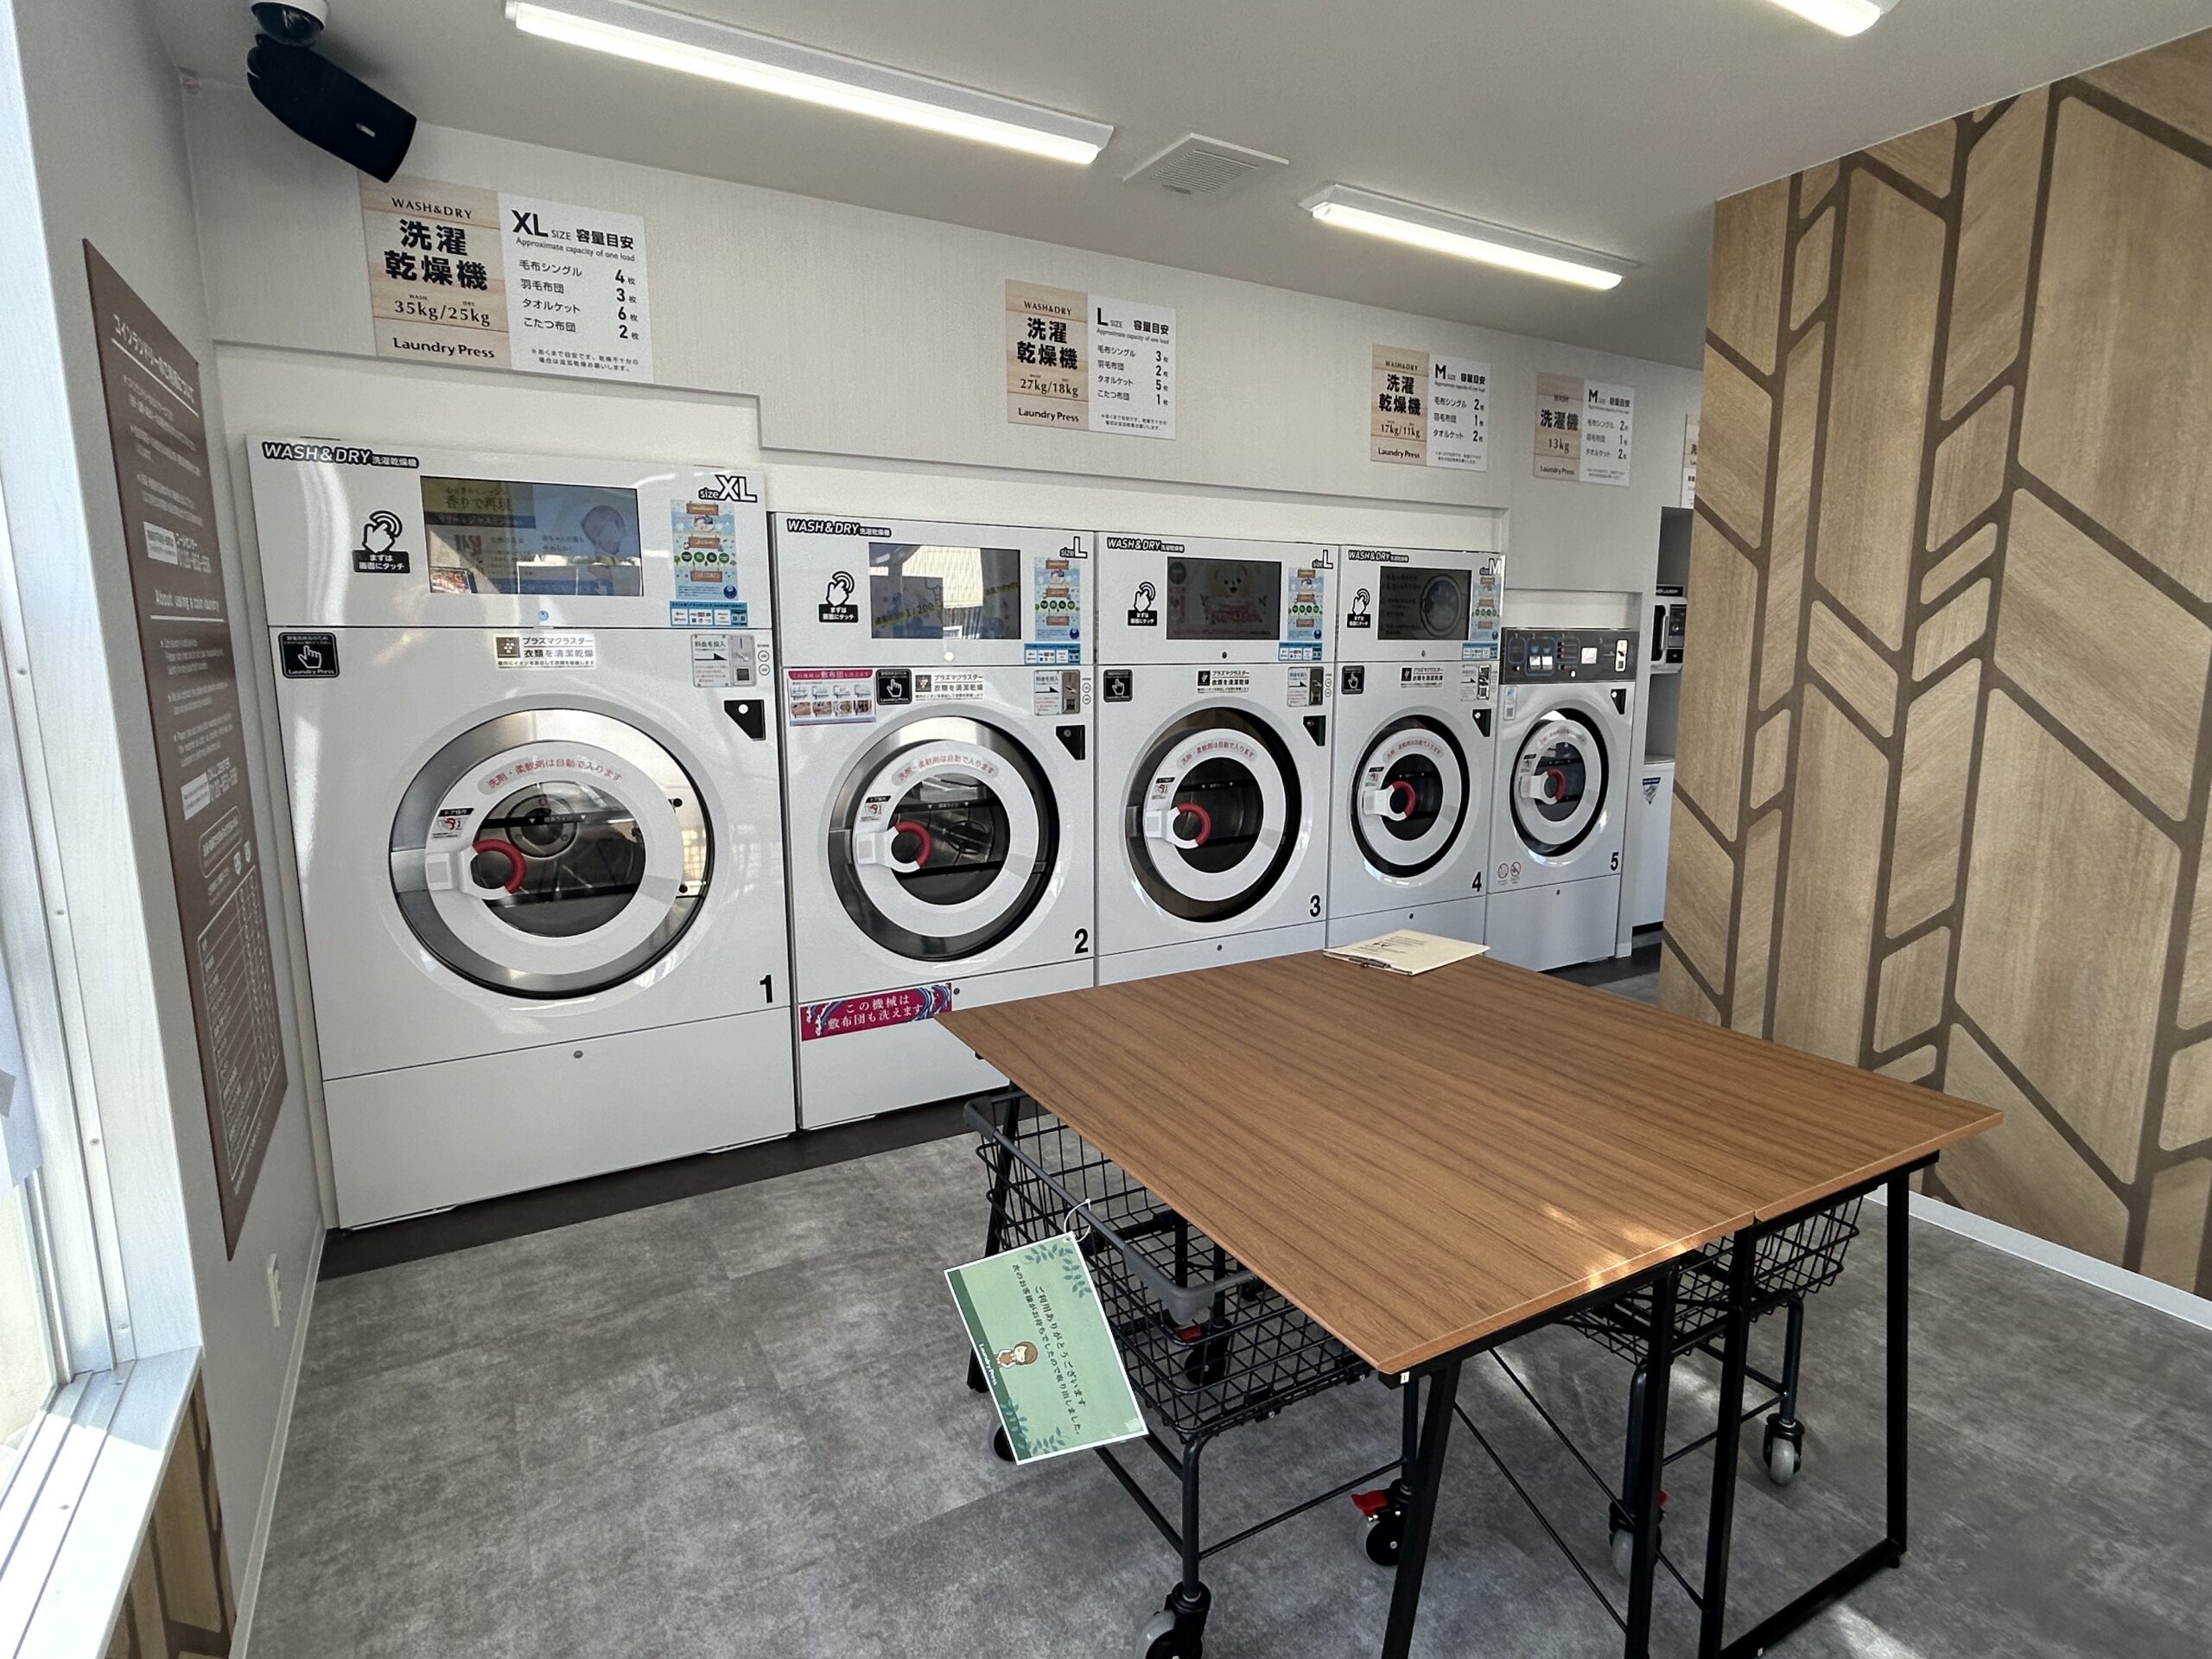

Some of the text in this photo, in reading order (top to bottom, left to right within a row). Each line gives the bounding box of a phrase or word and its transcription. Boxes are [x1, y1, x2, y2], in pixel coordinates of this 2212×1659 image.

[391, 197, 472, 219] WASH&DRY
[399, 219, 467, 257] 洗濯
[512, 209, 633, 250] XL SIZE 容量目安
[516, 237, 563, 251] Approximate
[566, 246, 594, 257] capacity
[620, 253, 635, 262] load
[384, 250, 488, 291] 乾燥機
[518, 258, 582, 277] 毛布シングル
[520, 278, 564, 295] 羽毛布団
[395, 300, 490, 327] 35kg/25kg
[522, 298, 581, 315] タオルケット
[1024, 301, 1072, 316] WASH&DRY
[524, 317, 576, 333] こたつ布団
[1027, 317, 1067, 344] 洗濯
[1097, 308, 1169, 335] L SIZE 容量目安
[393, 337, 495, 358] Laundry Press
[1017, 340, 1077, 370] 乾燥機
[1097, 345, 1136, 358] 毛布シングル
[1097, 359, 1124, 371] 羽毛布団
[1385, 360, 1419, 372] WASH&DRY
[1435, 363, 1446, 379] M
[1020, 378, 1078, 398] 27kg/18kg
[1098, 375, 1134, 386] タオルケット
[1387, 373, 1414, 394] 洗濯
[1098, 390, 1129, 401] こたつ布団
[1379, 392, 1421, 416] 乾燥機
[1588, 389, 1598, 403] M
[1018, 407, 1079, 423] Laundry Press
[1541, 409, 1579, 431] 洗濯機
[1381, 424, 1421, 439] 17kg/11kg
[263, 442, 417, 467] WASH&DRY 洗濯乾燥機
[1378, 448, 1420, 459] Laundry Press
[1548, 438, 1569, 454] 13kg
[1540, 466, 1561, 475] Laundry
[700, 474, 758, 503] size XL
[787, 519, 860, 535] WASH&DRY
[1060, 537, 1088, 559] size L
[1107, 537, 1161, 551] WASH&DRY
[1348, 550, 1391, 562] WASH&DRY
[1489, 558, 1502, 575] M
[524, 649, 594, 658] 衣類を清潔乾燥
[486, 758, 622, 788] 洗剤・柔軟剤は自動で入ります
[1611, 852, 1619, 871] 5
[1471, 872, 1482, 892] 4
[1309, 894, 1321, 918] 3
[1073, 928, 1089, 954] 2
[760, 974, 773, 1003] 1
[846, 995, 910, 1014] この機械は
[827, 1004, 924, 1030] 敷布団も洗えます
[1034, 1285, 1086, 1407] ご利用ありがとうございます
